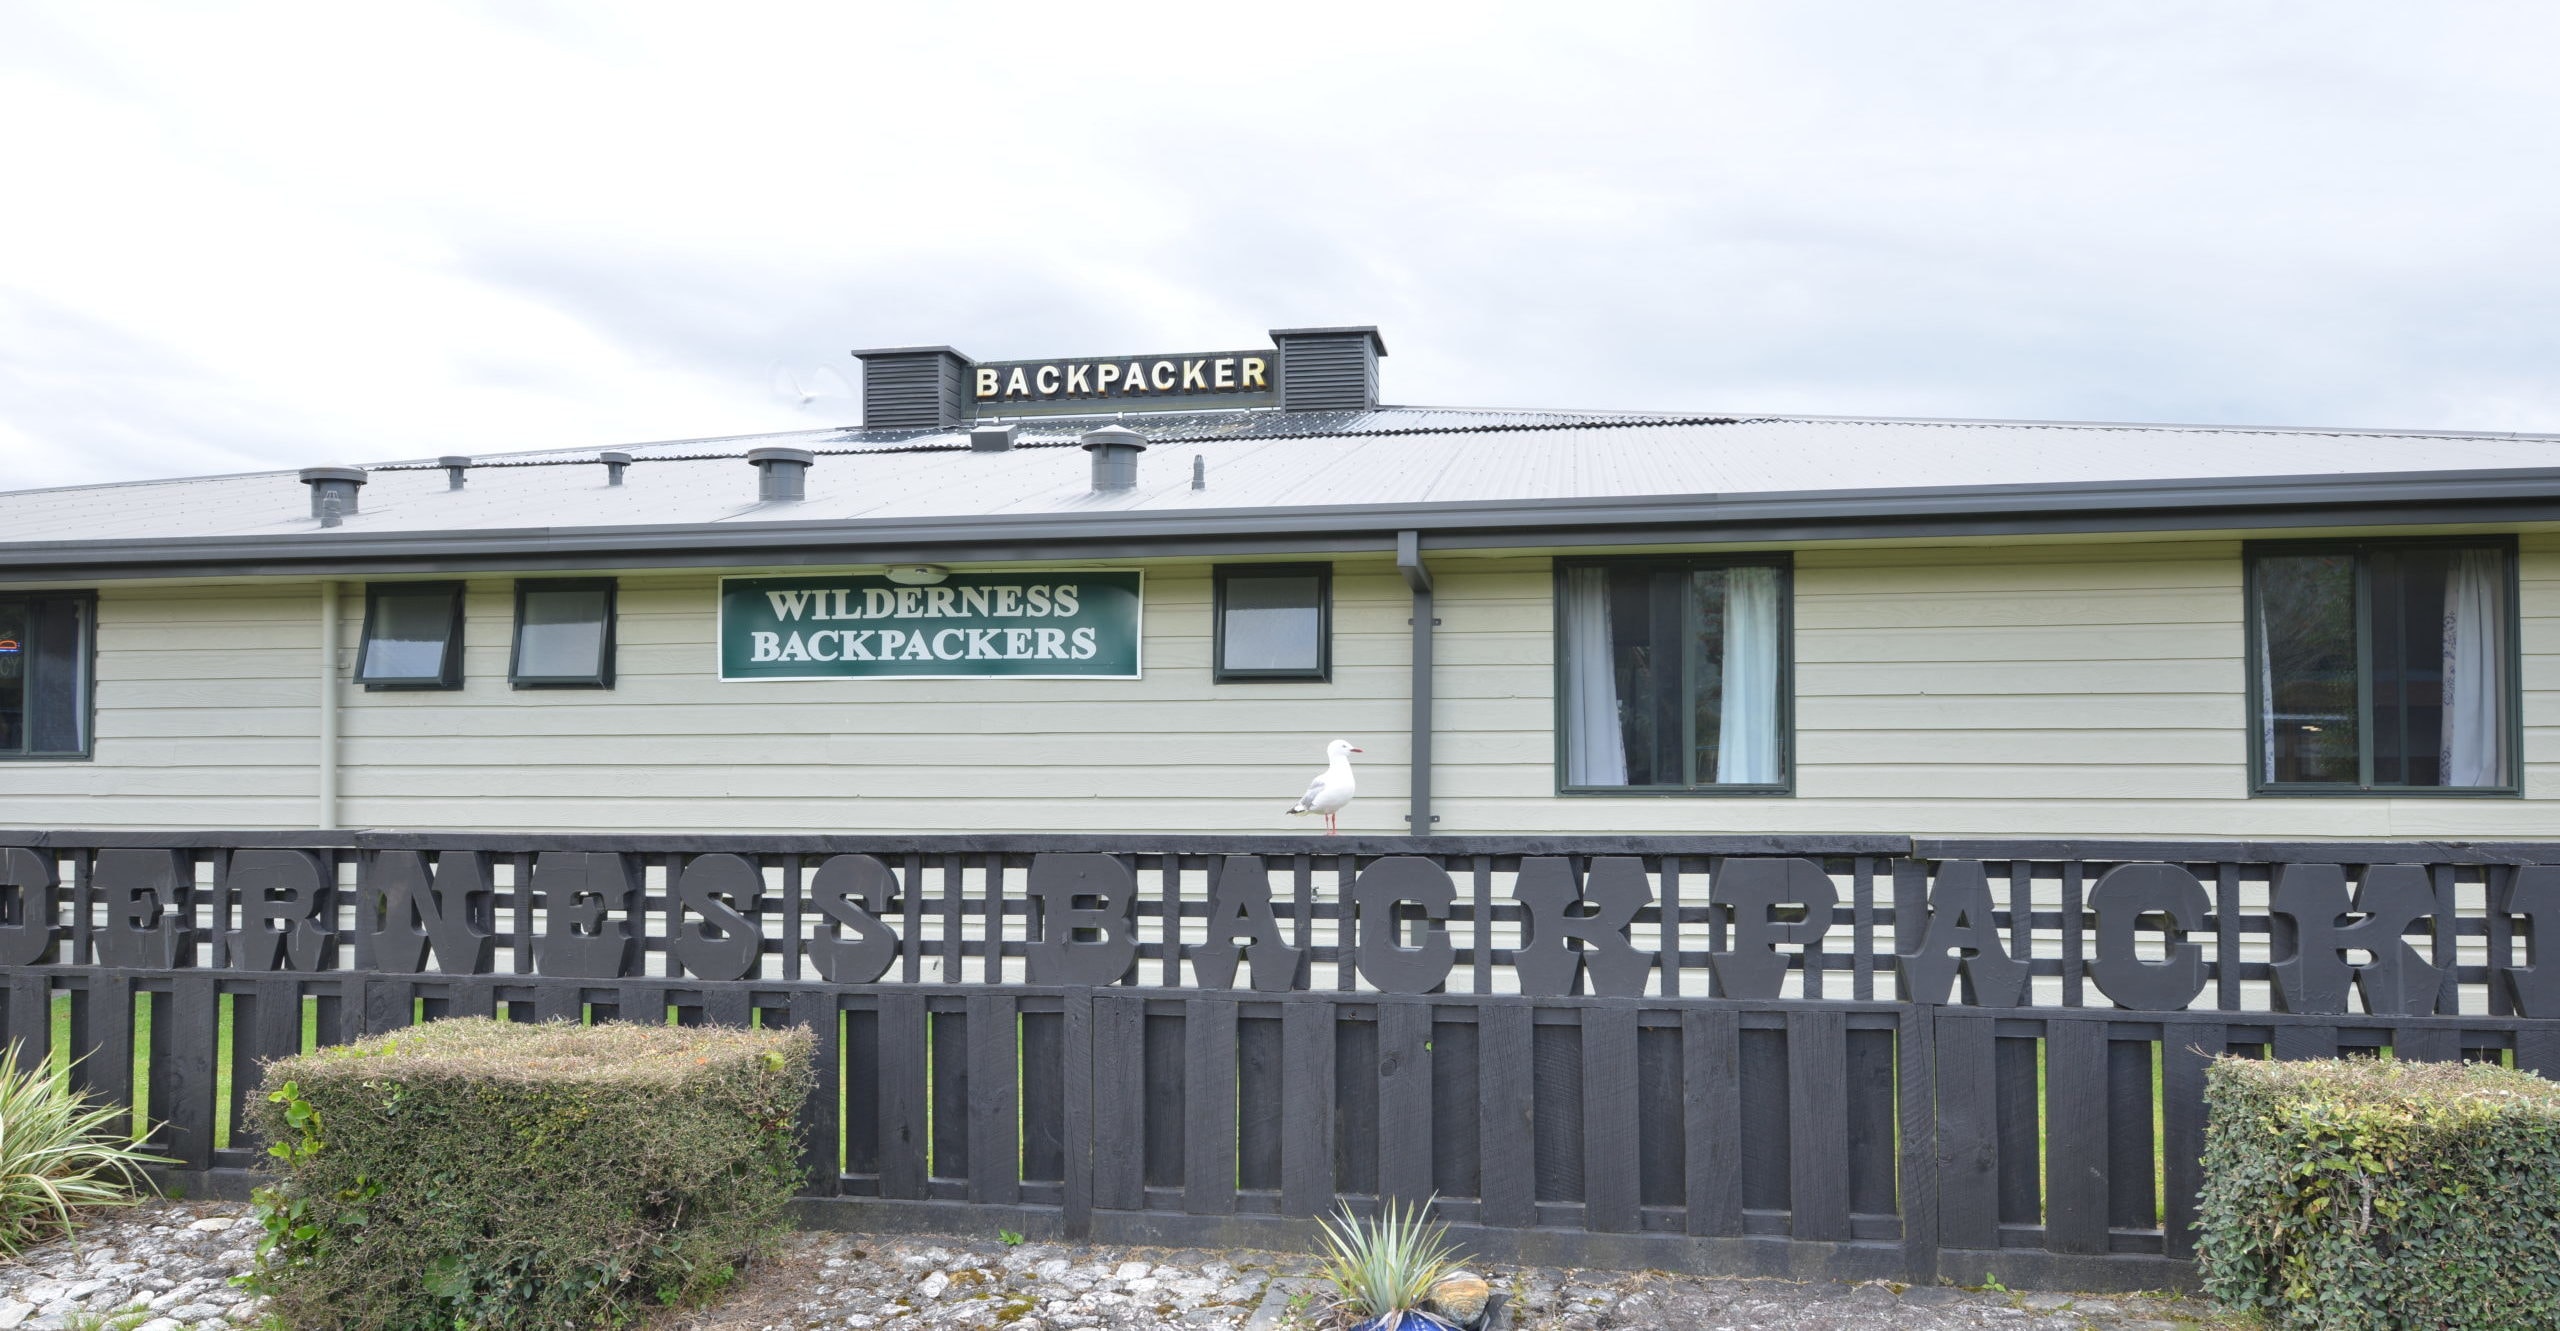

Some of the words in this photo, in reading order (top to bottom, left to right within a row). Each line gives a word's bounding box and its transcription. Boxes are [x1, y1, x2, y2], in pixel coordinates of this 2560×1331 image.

[975, 357, 1268, 398] BACKPACKER
[765, 584, 1080, 622] WILDERNESS
[750, 627, 1097, 662] BACKPACKERS
